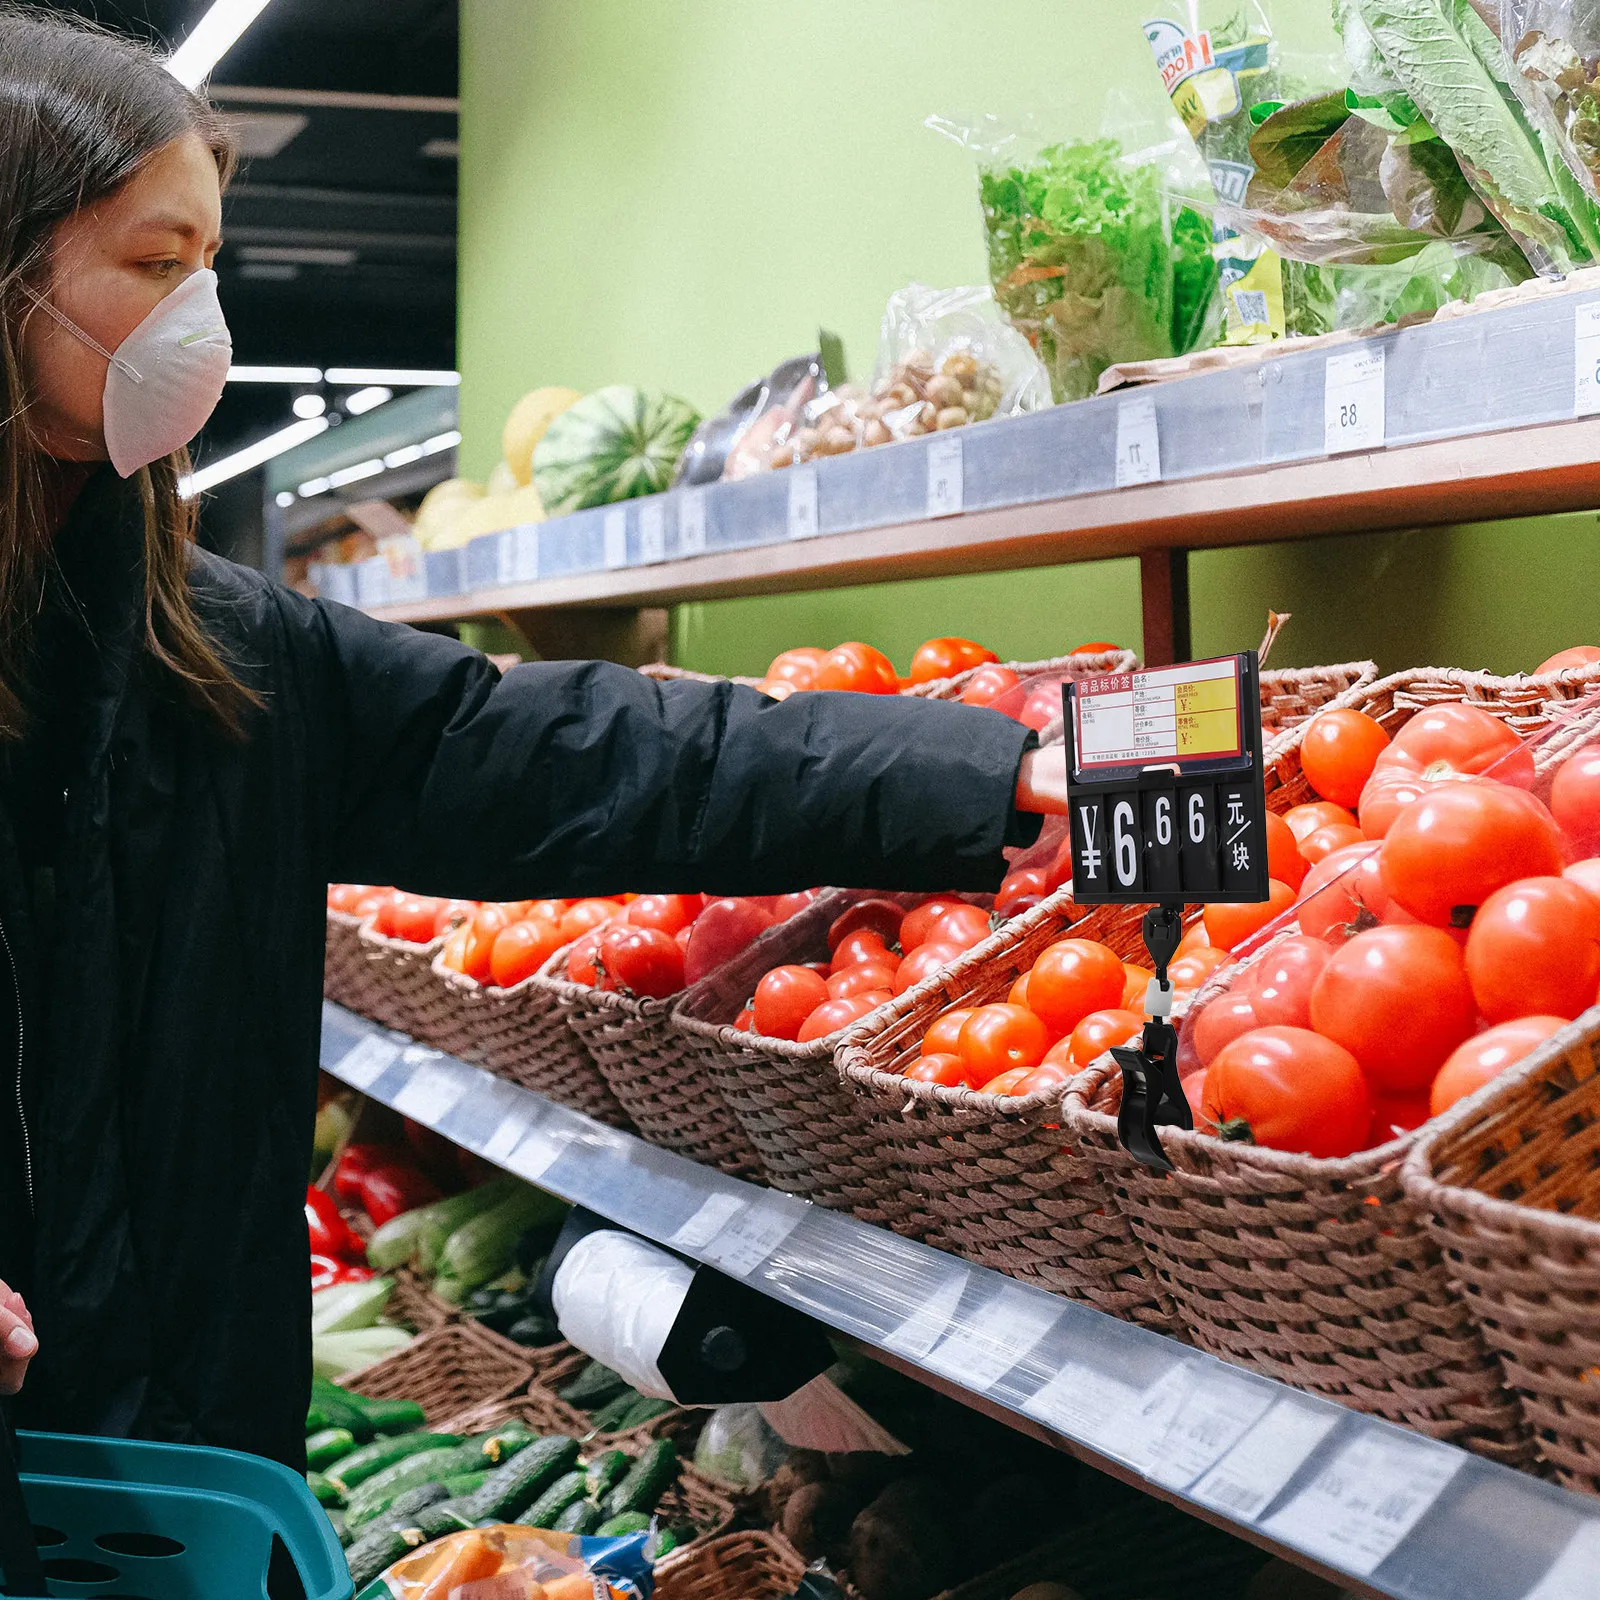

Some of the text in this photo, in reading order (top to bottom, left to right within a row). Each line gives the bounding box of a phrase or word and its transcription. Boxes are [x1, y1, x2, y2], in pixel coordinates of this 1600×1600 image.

[1080, 675, 1130, 694] 商品标价签
